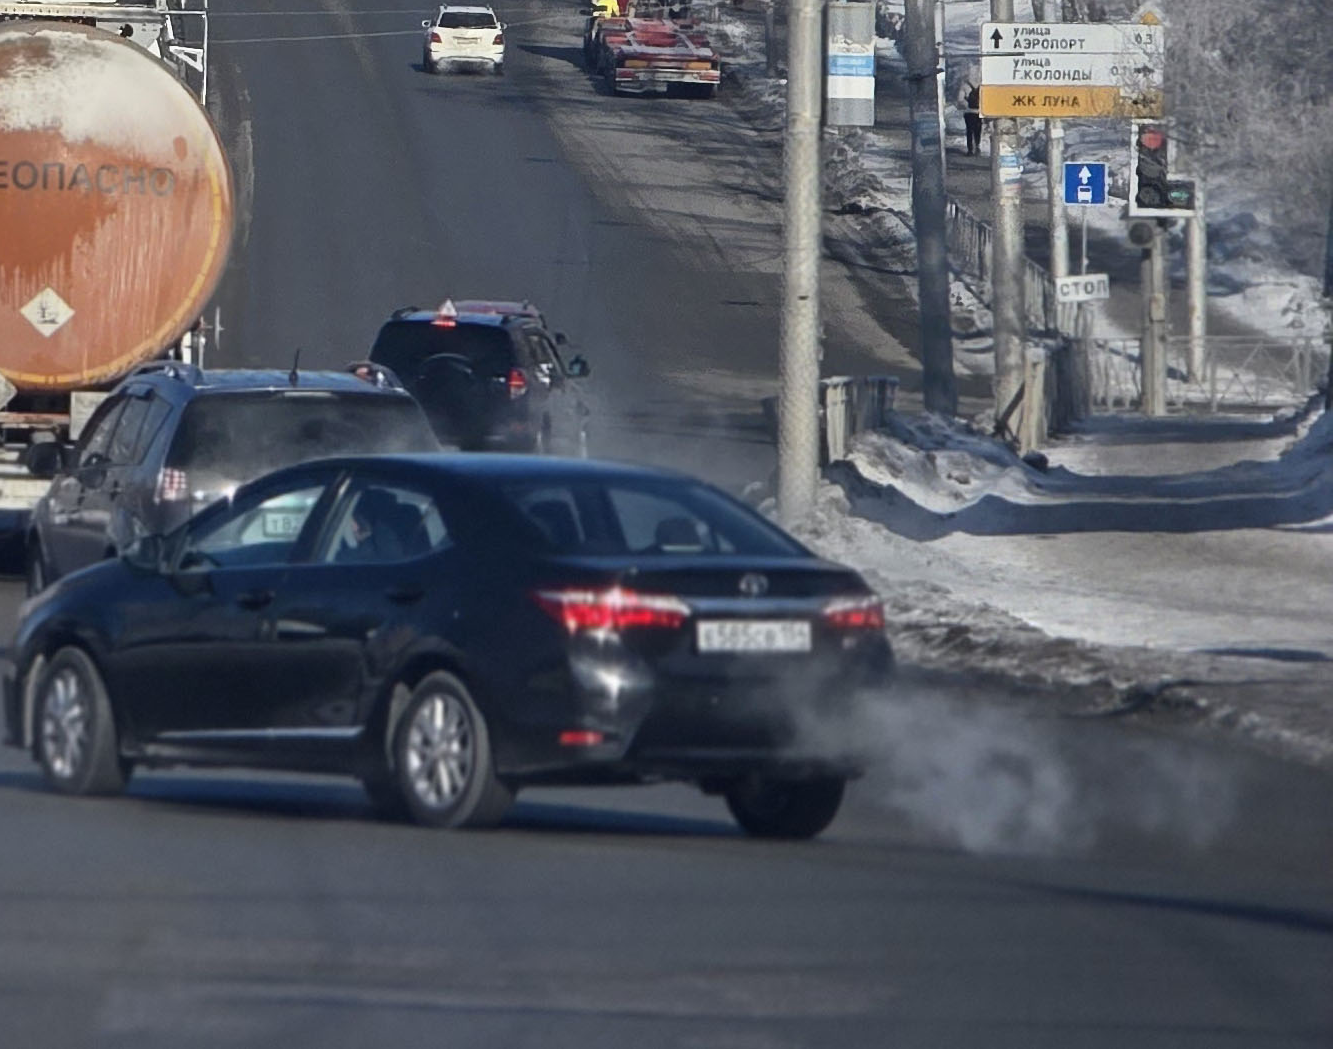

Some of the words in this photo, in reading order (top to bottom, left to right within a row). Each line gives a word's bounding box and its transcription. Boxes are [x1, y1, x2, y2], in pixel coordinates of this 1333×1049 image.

[1013, 27, 1051, 37] улица
[1013, 38, 1085, 50] АЭРОПОРТ
[1013, 57, 1051, 68] улица
[1012, 95, 1037, 106] ЖК
[1041, 95, 1081, 107] ЛУНА
[1060, 280, 1107, 297] СТОП
